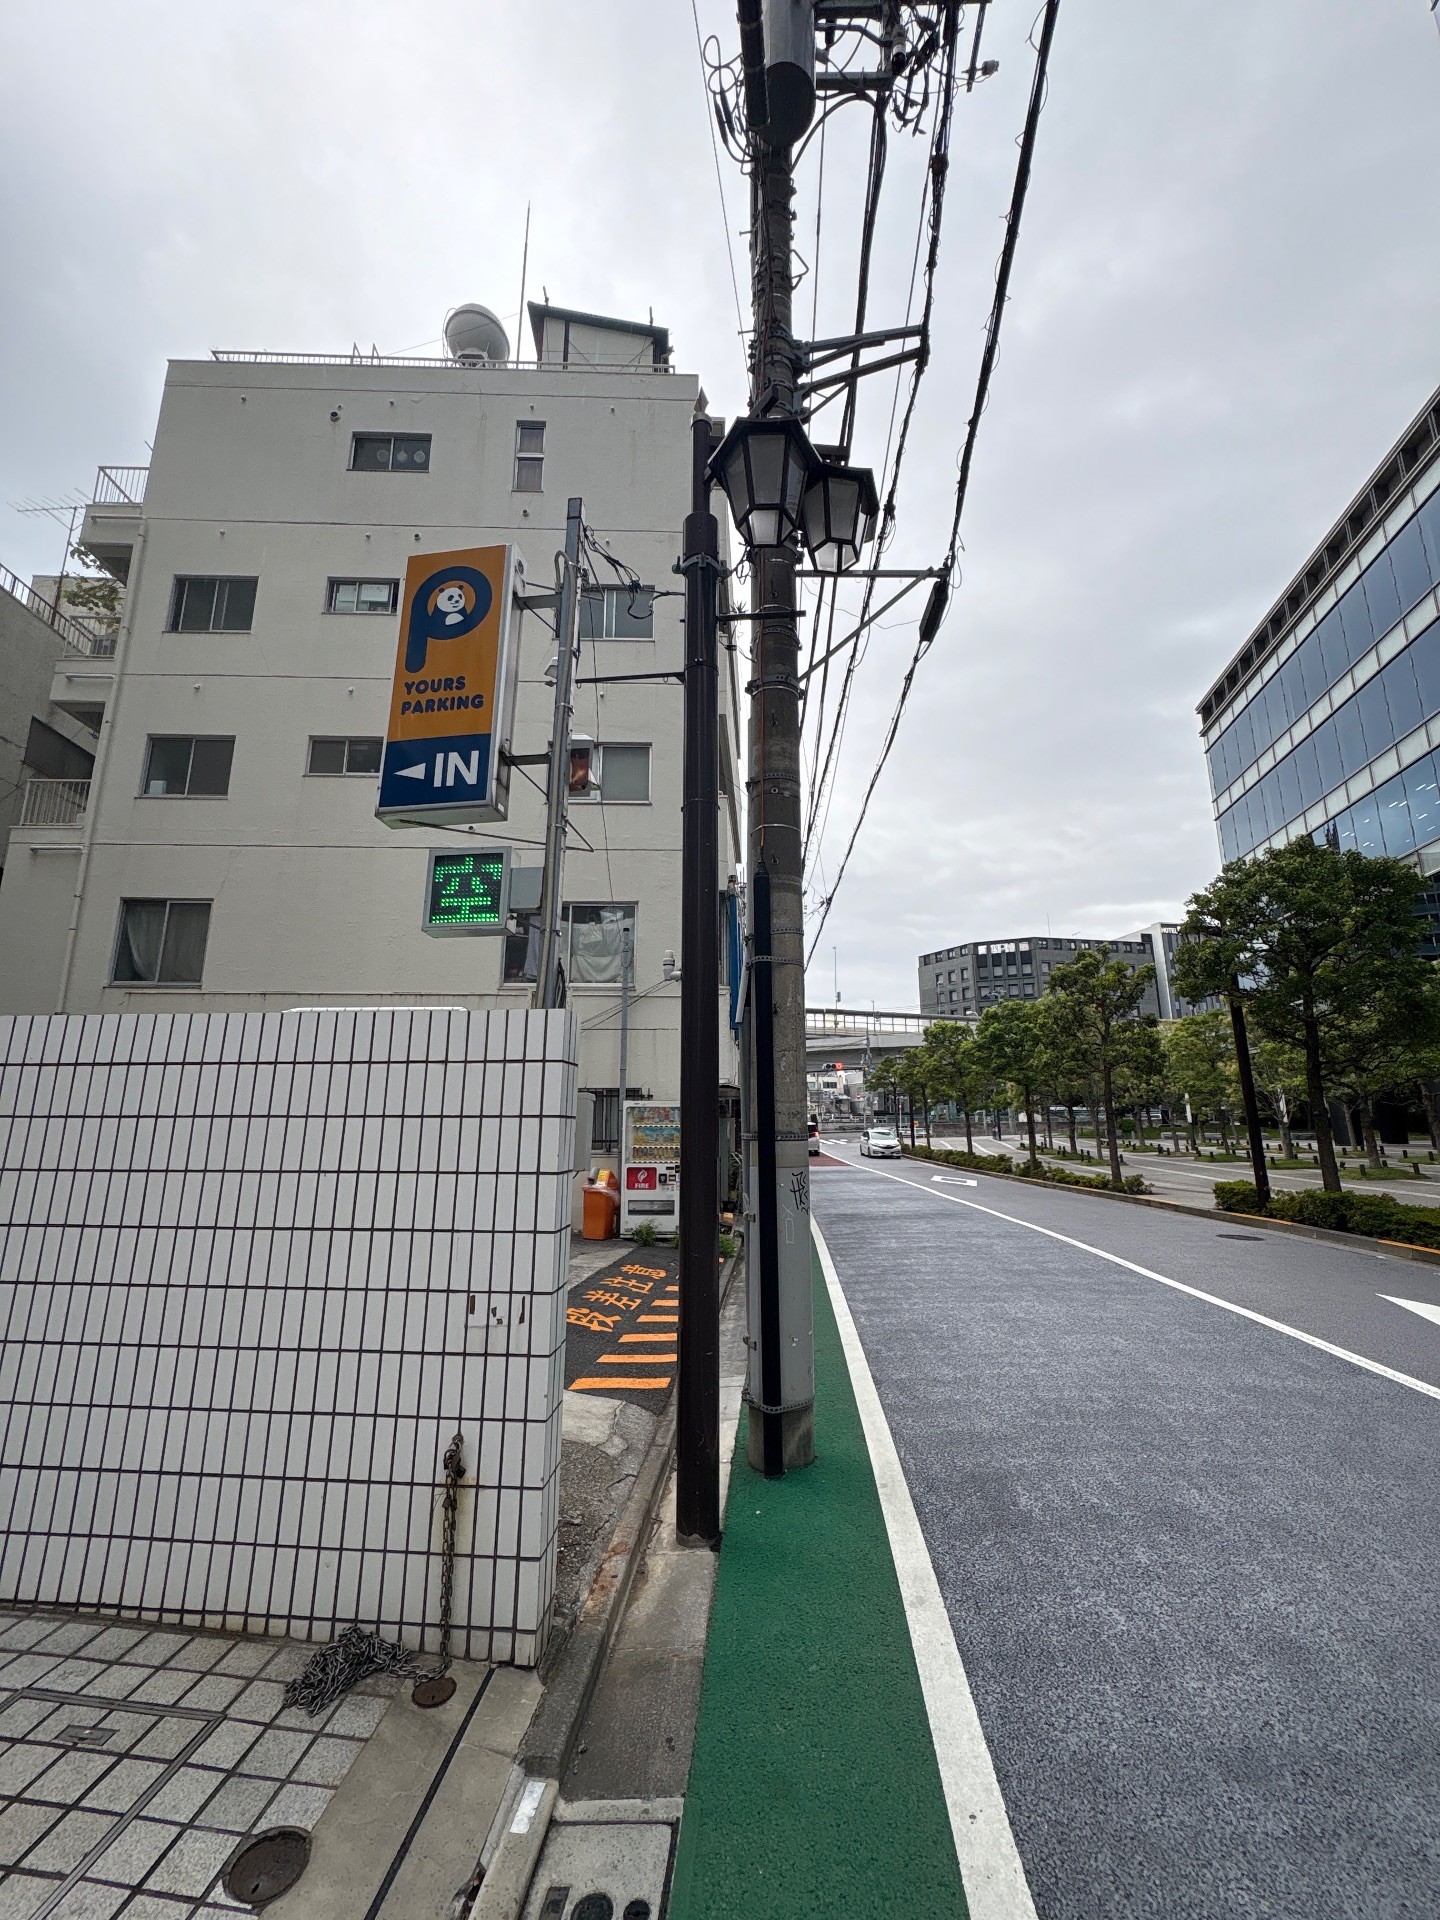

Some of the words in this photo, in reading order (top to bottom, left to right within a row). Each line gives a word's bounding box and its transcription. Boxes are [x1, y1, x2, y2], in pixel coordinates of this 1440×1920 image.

[405, 566, 492, 673] P
[401, 694, 484, 715] PARKING
[404, 676, 465, 695] YOURS
[433, 750, 480, 787] IN
[432, 856, 502, 924] 空
[566, 1264, 667, 1333] 段差注意
